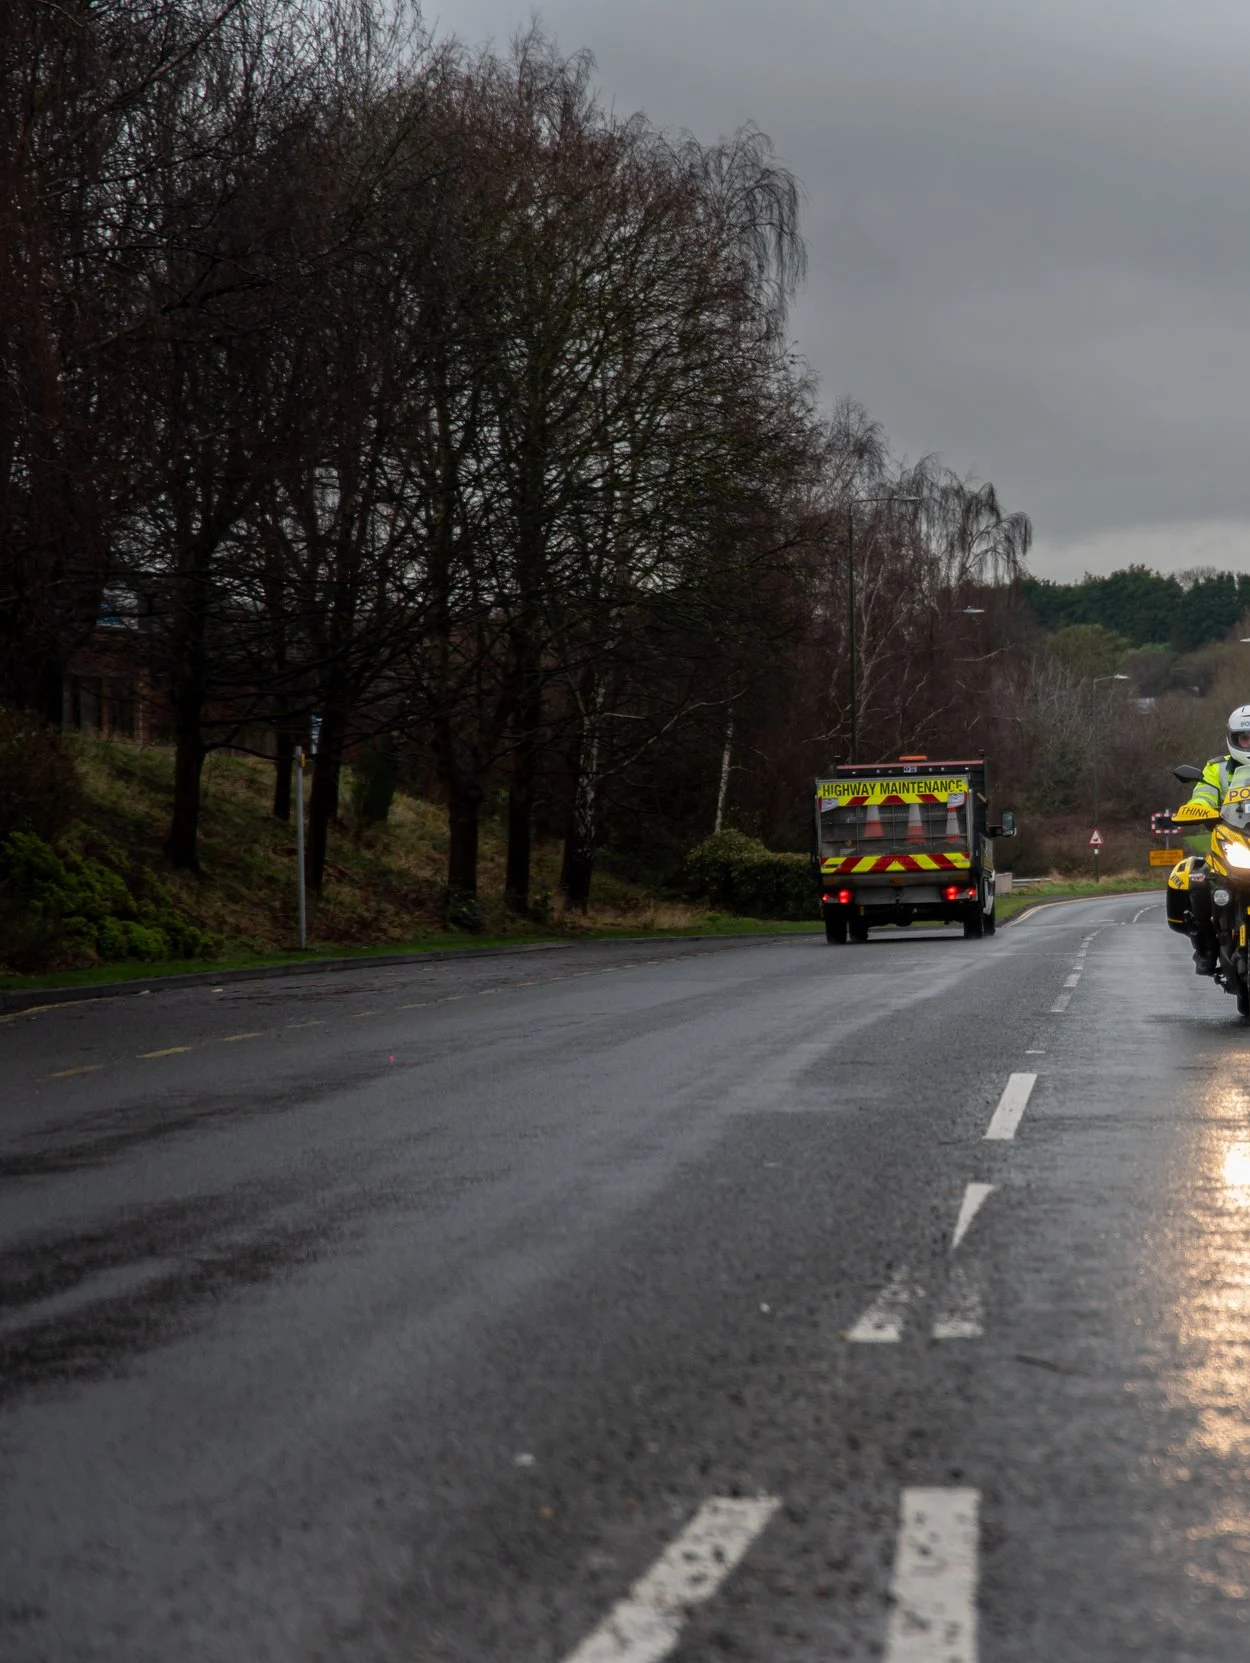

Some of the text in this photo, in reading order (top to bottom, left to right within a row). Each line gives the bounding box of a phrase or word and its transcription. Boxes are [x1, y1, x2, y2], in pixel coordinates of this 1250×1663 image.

[822, 779, 964, 798] HIGHWAY MAINTENANCE
[1180, 806, 1211, 819] THINK
